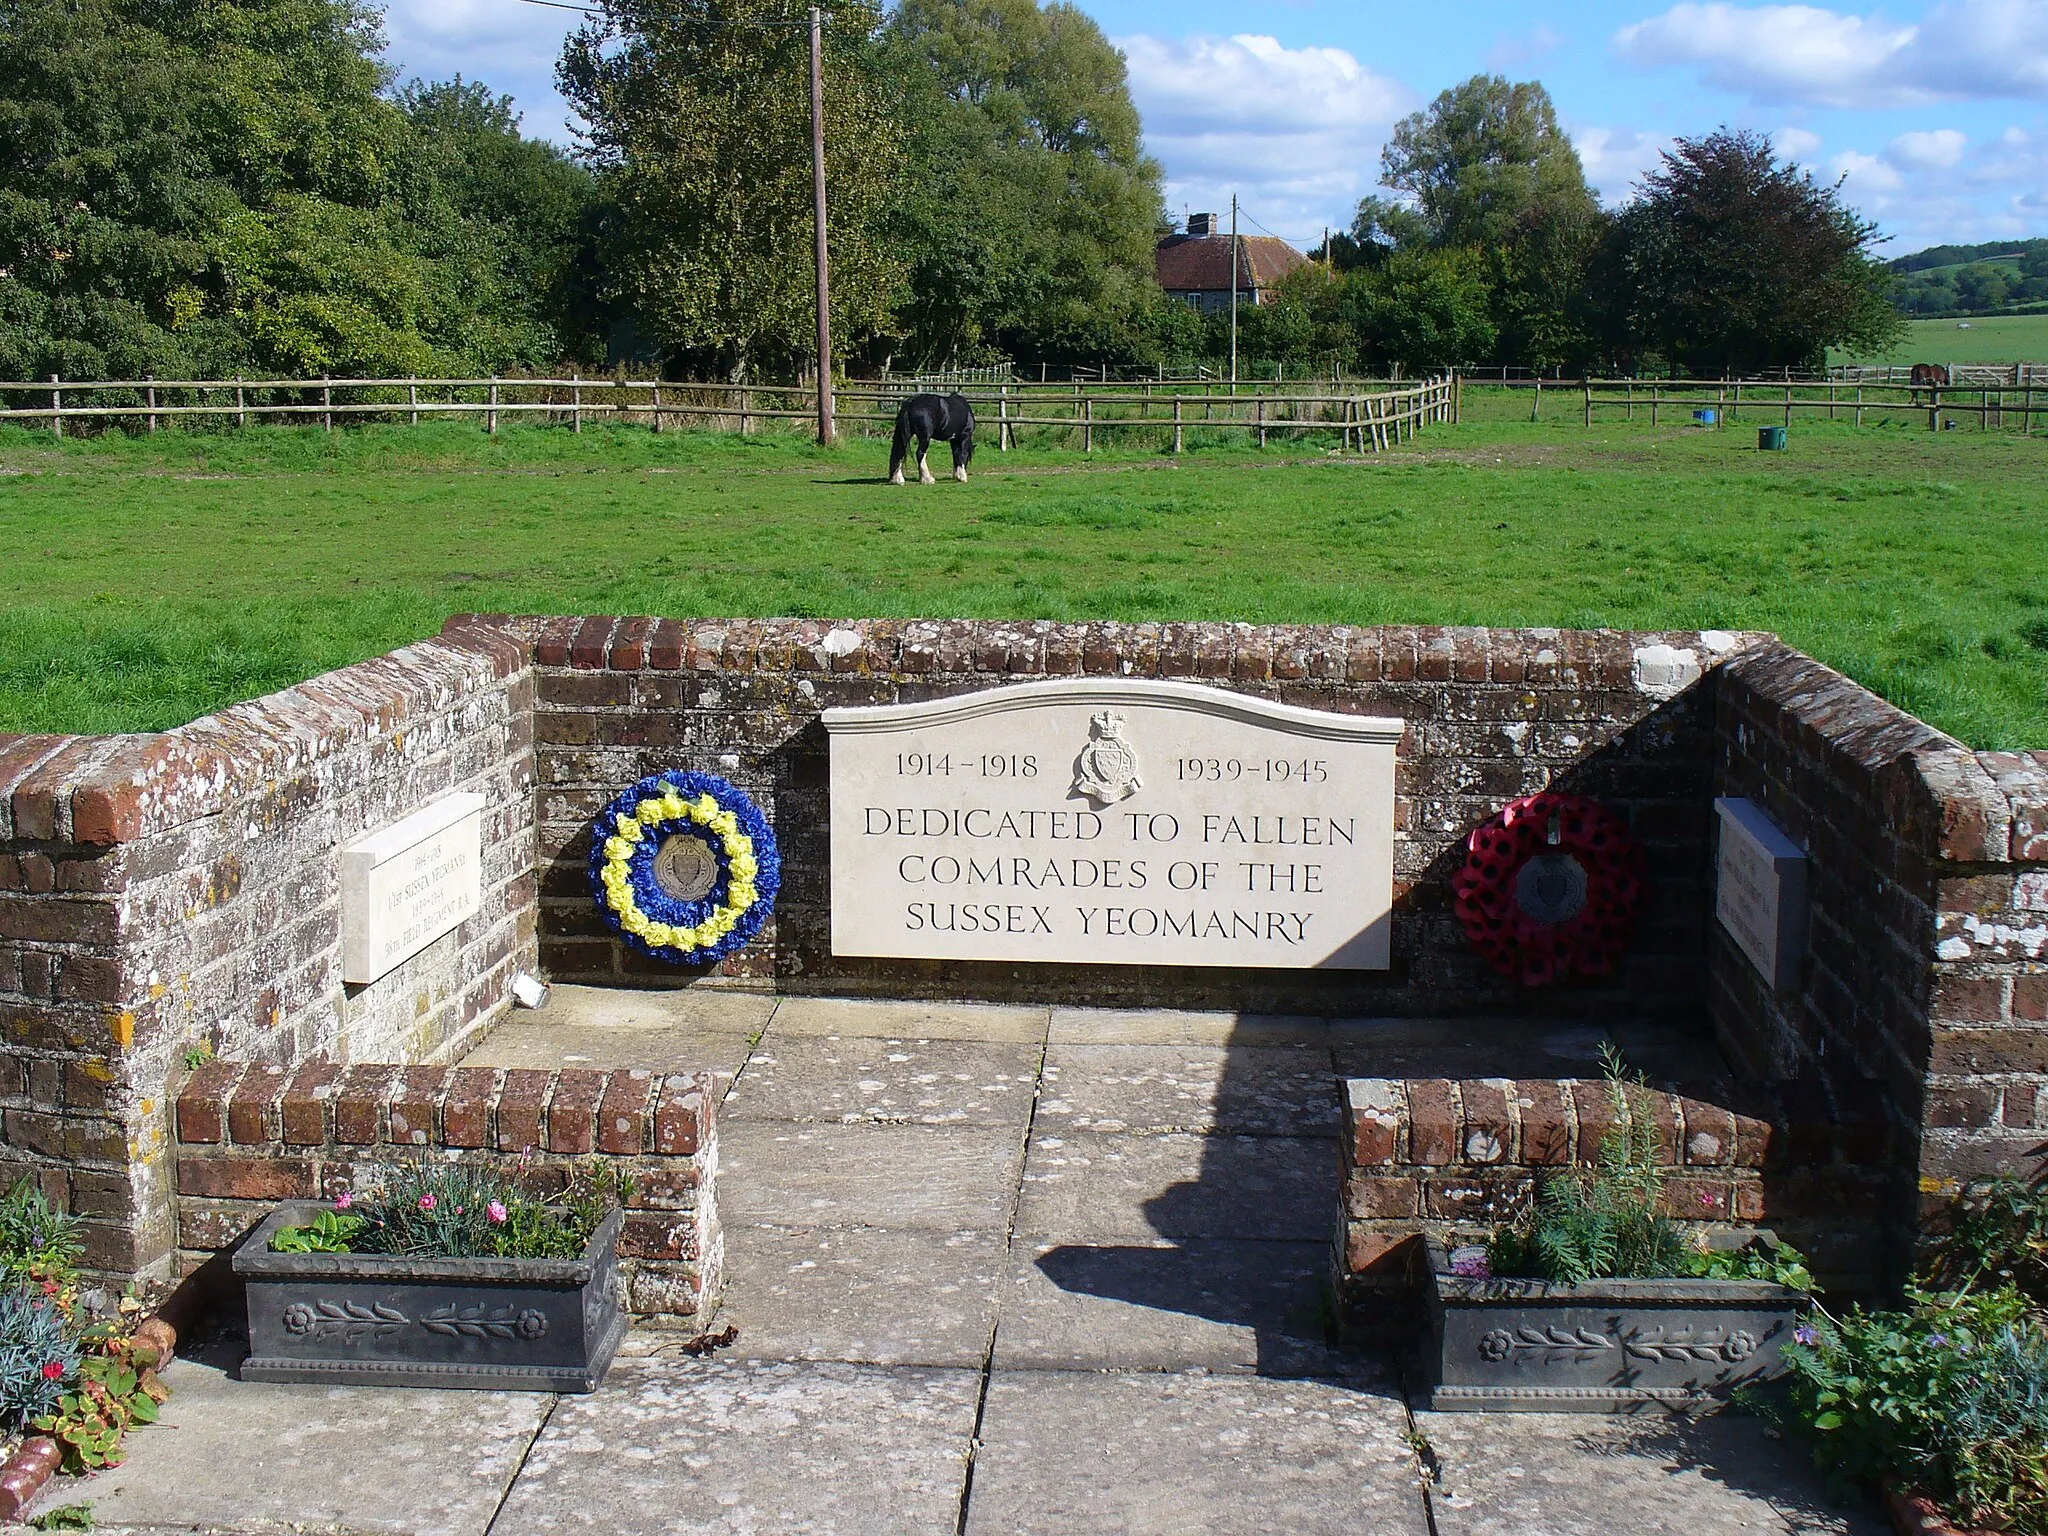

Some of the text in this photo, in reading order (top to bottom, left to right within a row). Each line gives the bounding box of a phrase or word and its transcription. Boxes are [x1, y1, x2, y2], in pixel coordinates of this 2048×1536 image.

[897, 752, 1038, 779] 1914-1918
[1177, 758, 1329, 783] 1939-1945
[862, 807, 1358, 846] DEDICATED TO FALLEN
[898, 854, 1324, 894] COMRADES OF THE
[402, 923, 421, 947] FIELD
[423, 899, 456, 934] REGIMENT
[905, 902, 1315, 946] SUSSEX YEOMANRY
